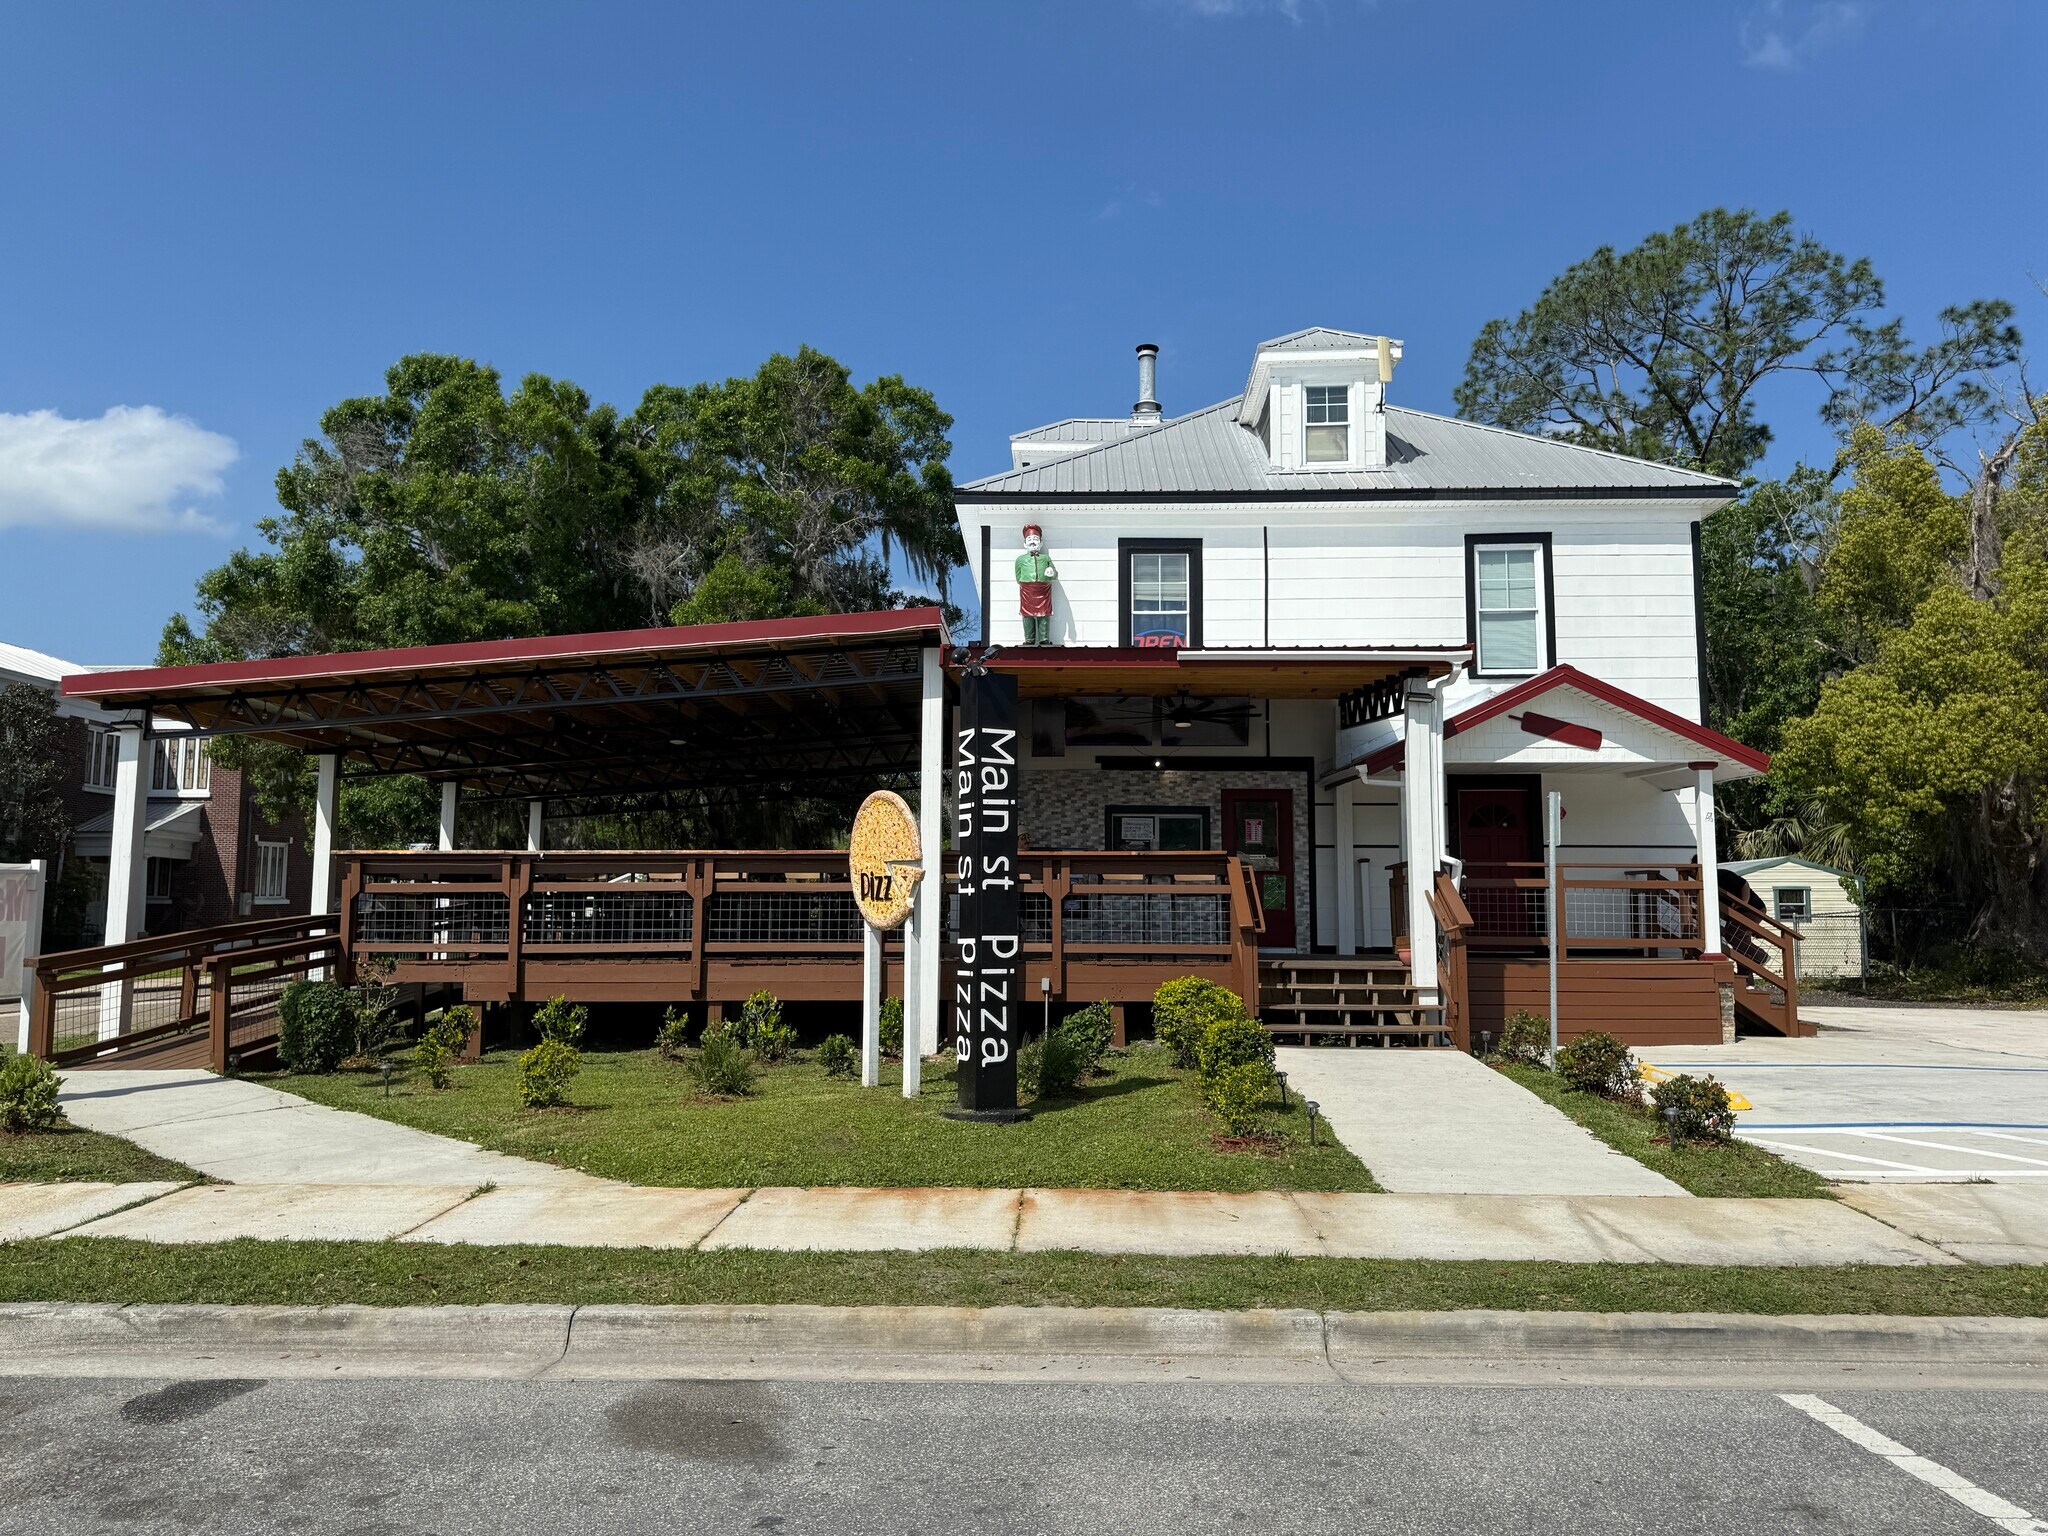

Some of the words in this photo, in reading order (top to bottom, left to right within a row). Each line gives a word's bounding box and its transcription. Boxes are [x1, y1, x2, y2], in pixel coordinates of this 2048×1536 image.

[958, 728, 976, 838] Main
[981, 728, 1016, 833] Main
[980, 935, 1018, 1068] Pizza
